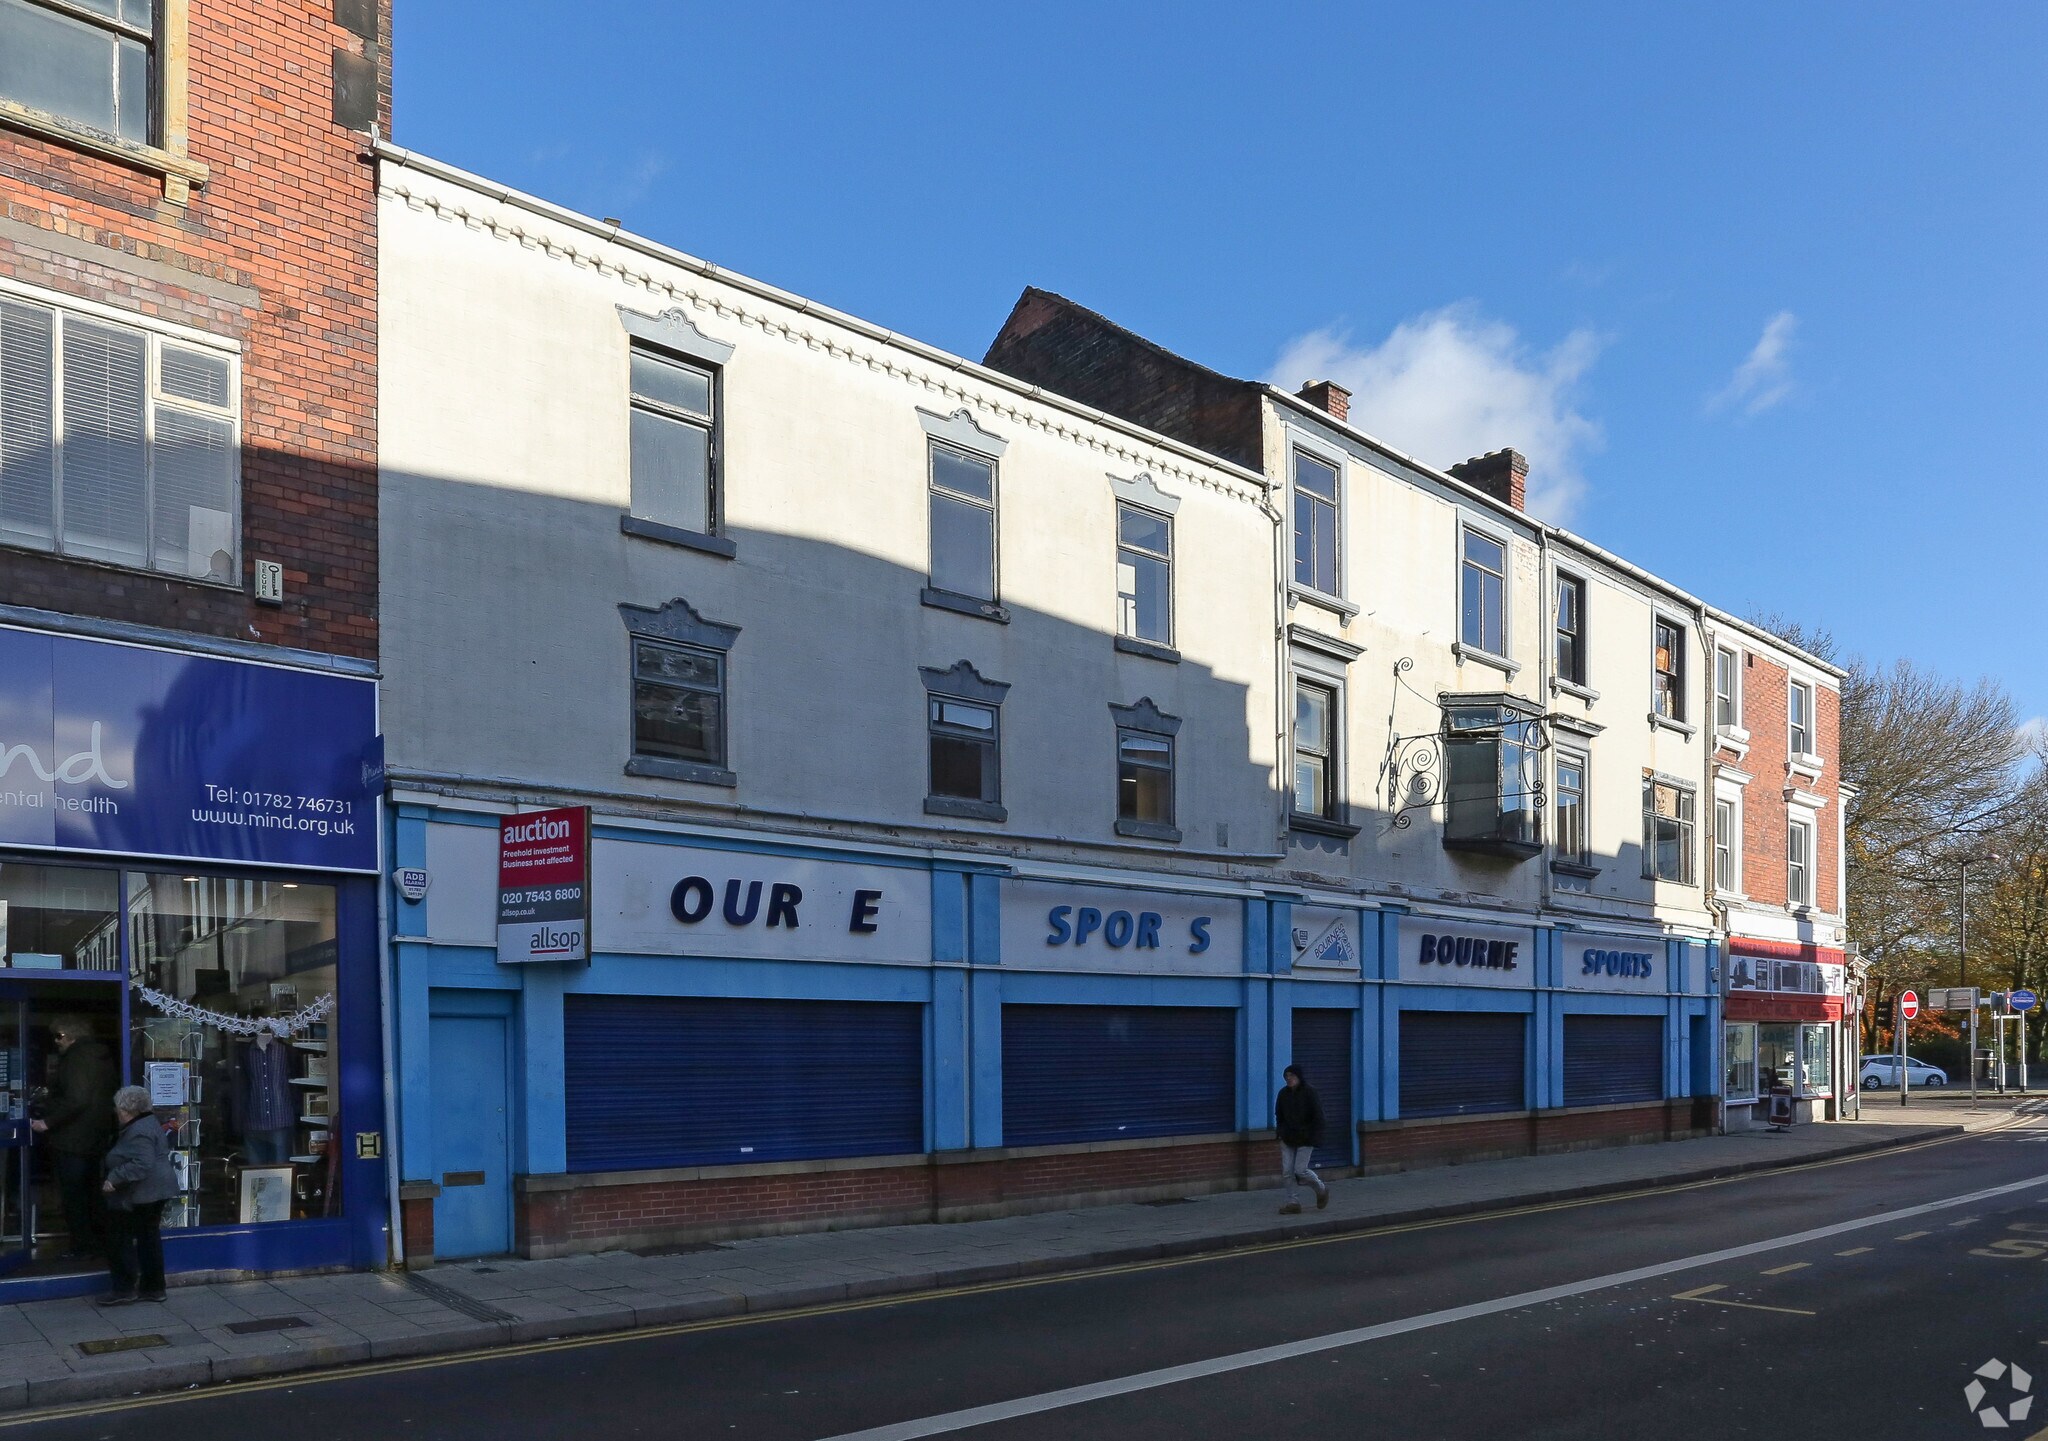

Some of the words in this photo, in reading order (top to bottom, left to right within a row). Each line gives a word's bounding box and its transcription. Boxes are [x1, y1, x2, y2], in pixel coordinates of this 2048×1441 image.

[54, 792, 118, 815] health
[205, 783, 239, 803] Tel:
[243, 791, 293, 809] 01782
[296, 796, 352, 815] 746731
[192, 808, 355, 836] www.mind.org.uk
[504, 816, 570, 845] auction
[503, 848, 532, 858] Freehold
[533, 844, 570, 856] investment
[503, 860, 533, 869] Business
[534, 858, 546, 866] not
[546, 854, 574, 865] affected
[404, 879, 426, 887] ALARMS
[405, 872, 425, 881] ADB
[502, 892, 523, 905] 020
[525, 890, 552, 903] 7543
[554, 887, 581, 901] 6800
[502, 907, 536, 918] allsop.co.uk
[530, 926, 580, 952] allsop
[1314, 927, 1340, 958] BOURNE
[1338, 922, 1355, 960] SPORTS
[1420, 934, 1519, 970] BOURNE
[1582, 948, 1653, 978] SPORTS
